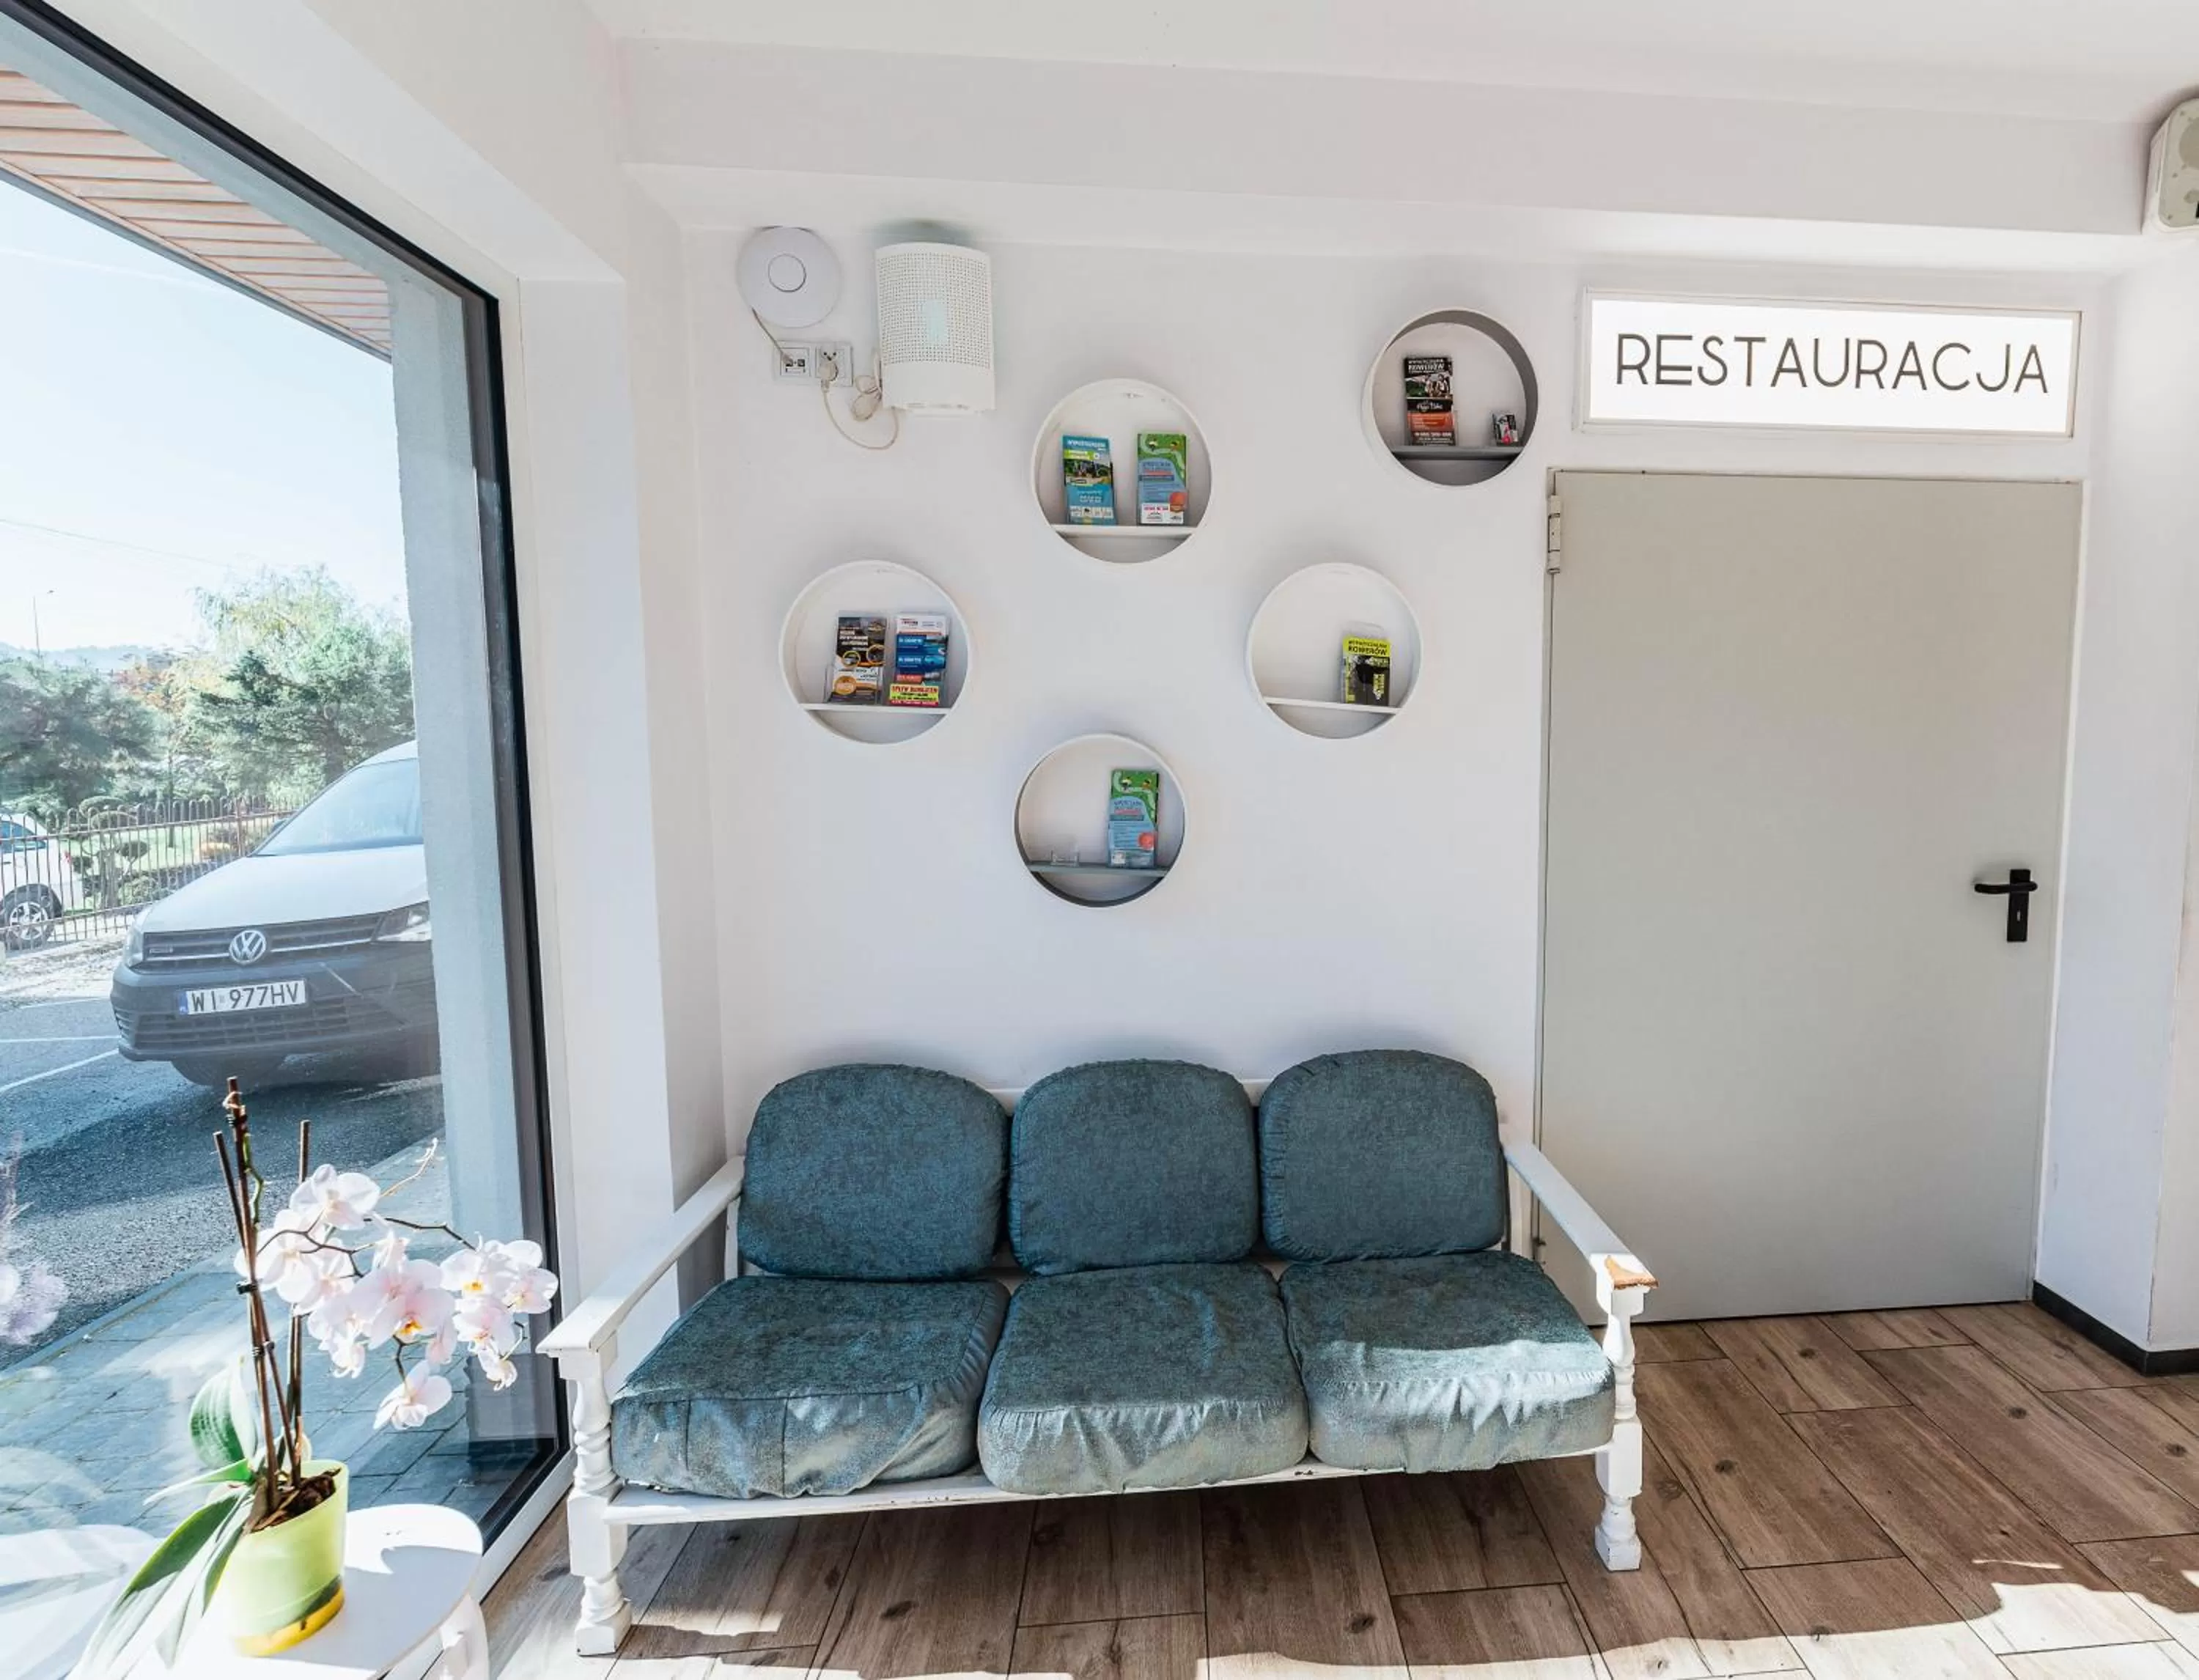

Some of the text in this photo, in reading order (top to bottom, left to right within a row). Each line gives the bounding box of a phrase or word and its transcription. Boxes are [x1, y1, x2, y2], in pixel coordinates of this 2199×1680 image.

[1616, 333, 2048, 394] RESTAURACJA
[191, 983, 298, 1012] WI 977HV
